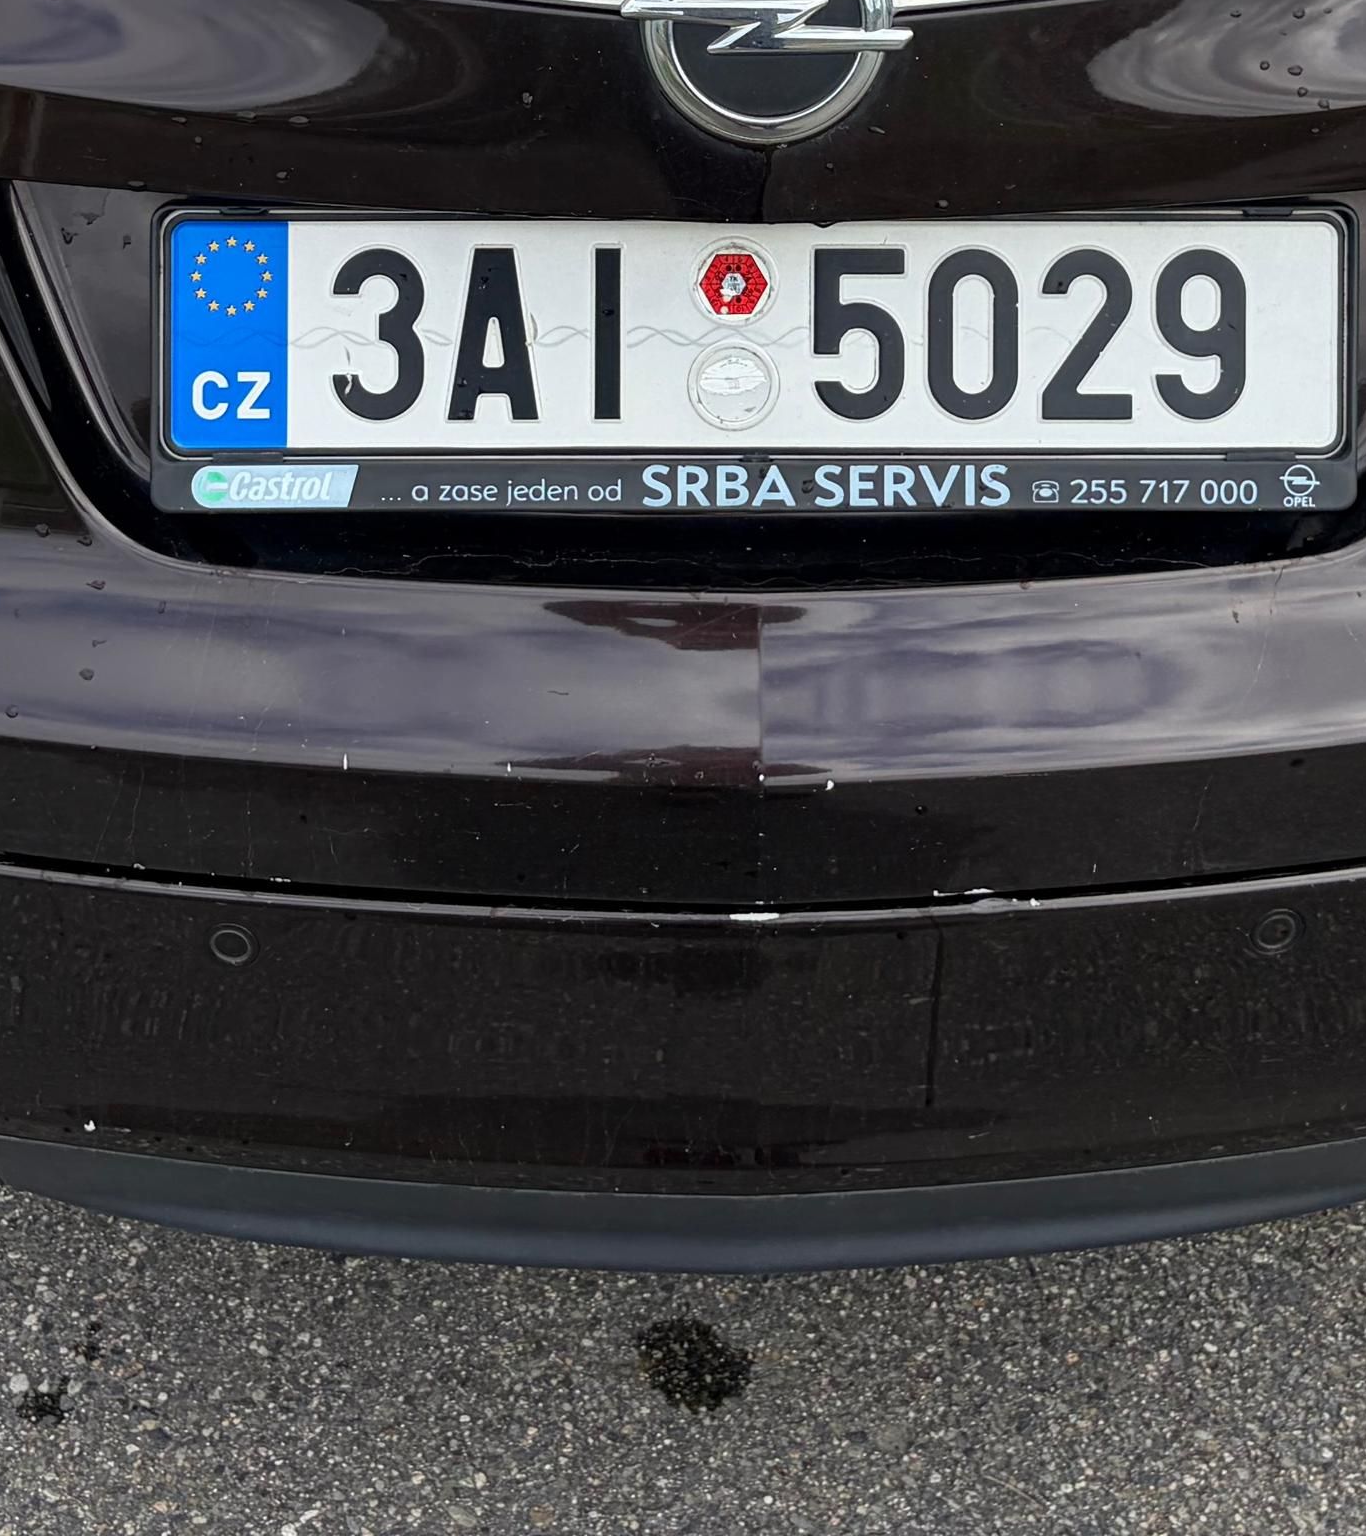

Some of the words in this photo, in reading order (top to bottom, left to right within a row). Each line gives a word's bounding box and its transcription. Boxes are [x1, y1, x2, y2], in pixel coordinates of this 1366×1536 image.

[332, 247, 622, 421] 3AI
[813, 247, 1247, 420] 5029
[191, 370, 271, 420] CZ
[229, 471, 333, 502] Castrol
[411, 484, 429, 502] a
[438, 484, 499, 502] zase
[506, 478, 579, 507] jeden
[587, 478, 623, 502] od
[641, 464, 797, 507] SRBA
[813, 464, 1012, 507] SERVIS
[1069, 479, 1128, 505] 255
[1139, 479, 1191, 505] 717
[1199, 479, 1259, 505] 000
[1282, 495, 1317, 508] OPEL
